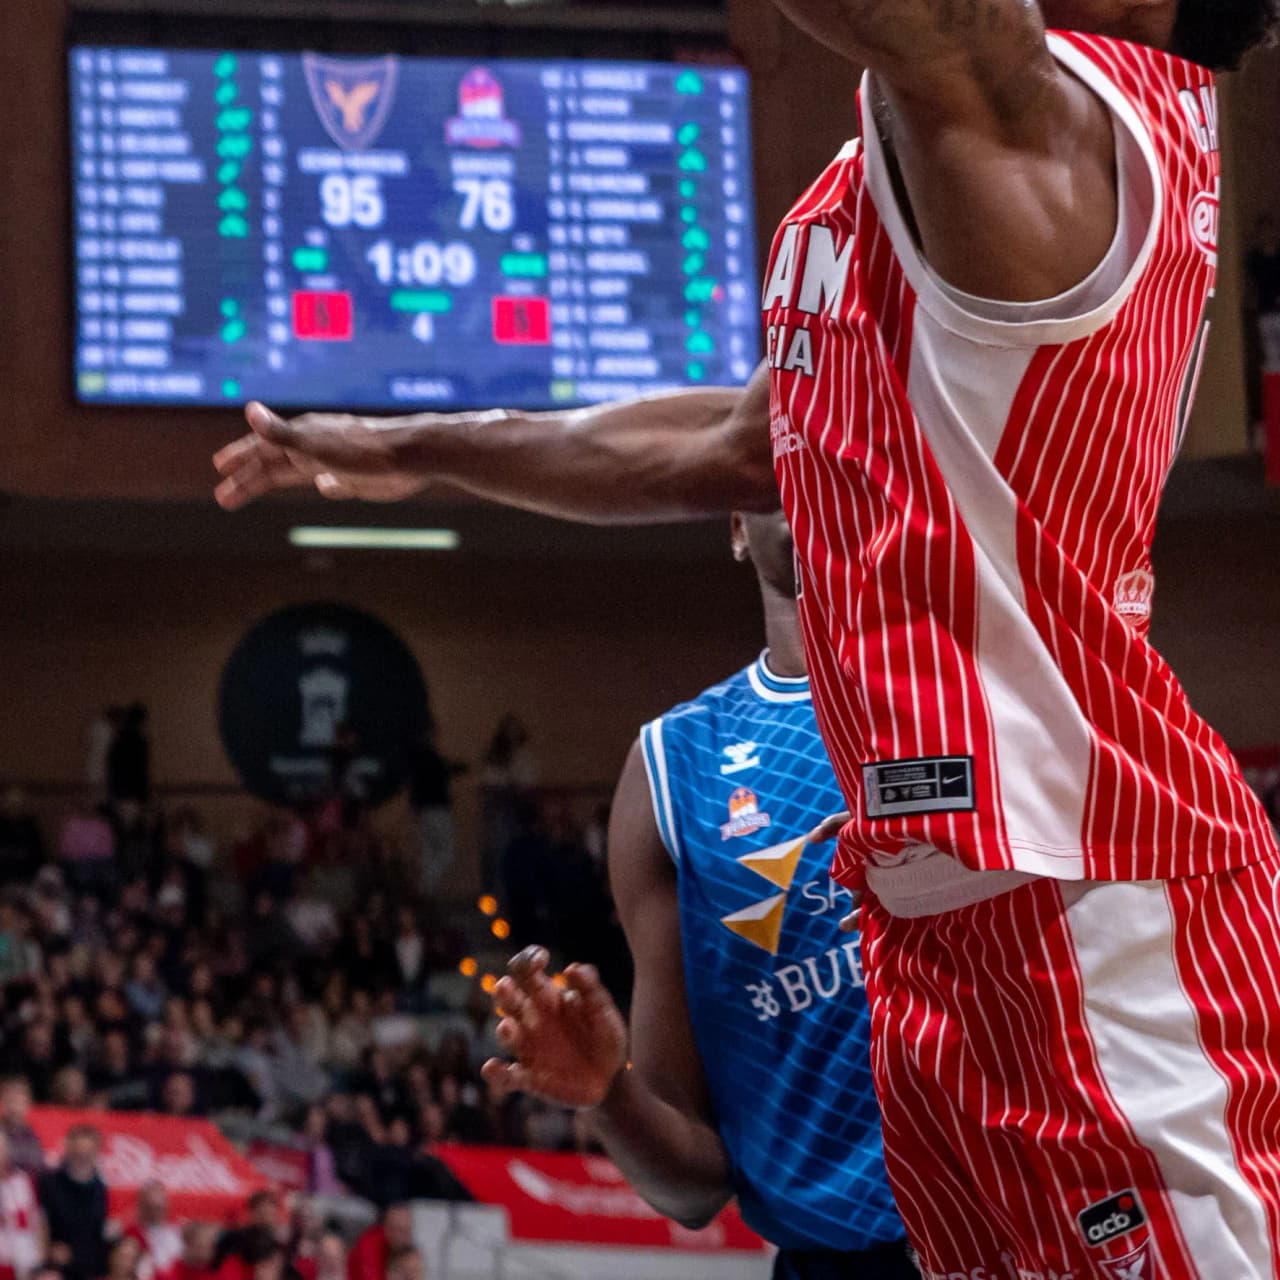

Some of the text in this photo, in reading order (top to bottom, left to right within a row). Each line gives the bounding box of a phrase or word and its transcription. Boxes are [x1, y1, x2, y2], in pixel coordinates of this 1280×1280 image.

[320, 174, 384, 228] 95
[453, 179, 514, 231] 76
[367, 241, 477, 285] 1:09
[1087, 1212, 1131, 1242] acb
